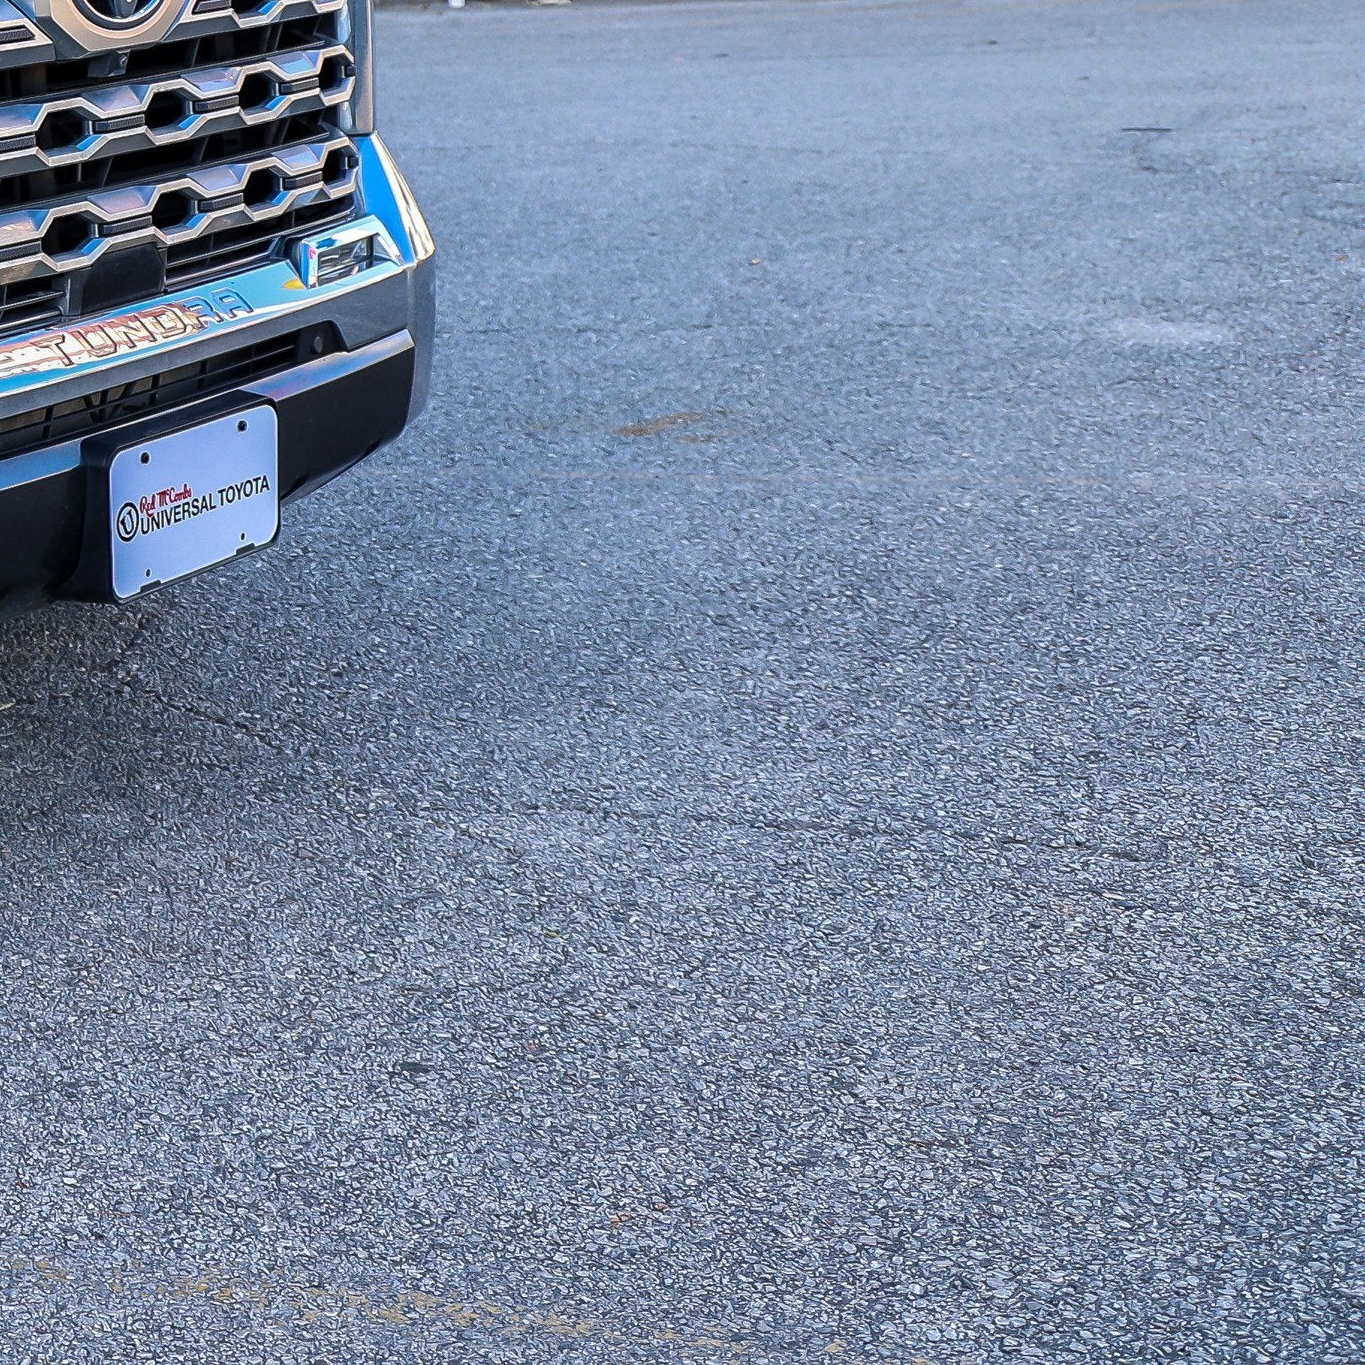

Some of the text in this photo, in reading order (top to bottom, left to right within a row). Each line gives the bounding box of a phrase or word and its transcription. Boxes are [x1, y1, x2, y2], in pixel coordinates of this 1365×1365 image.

[31, 287, 255, 367] TUNDRA
[139, 493, 157, 517] Red
[140, 475, 271, 535] UNIVERSAL TOYOTA
